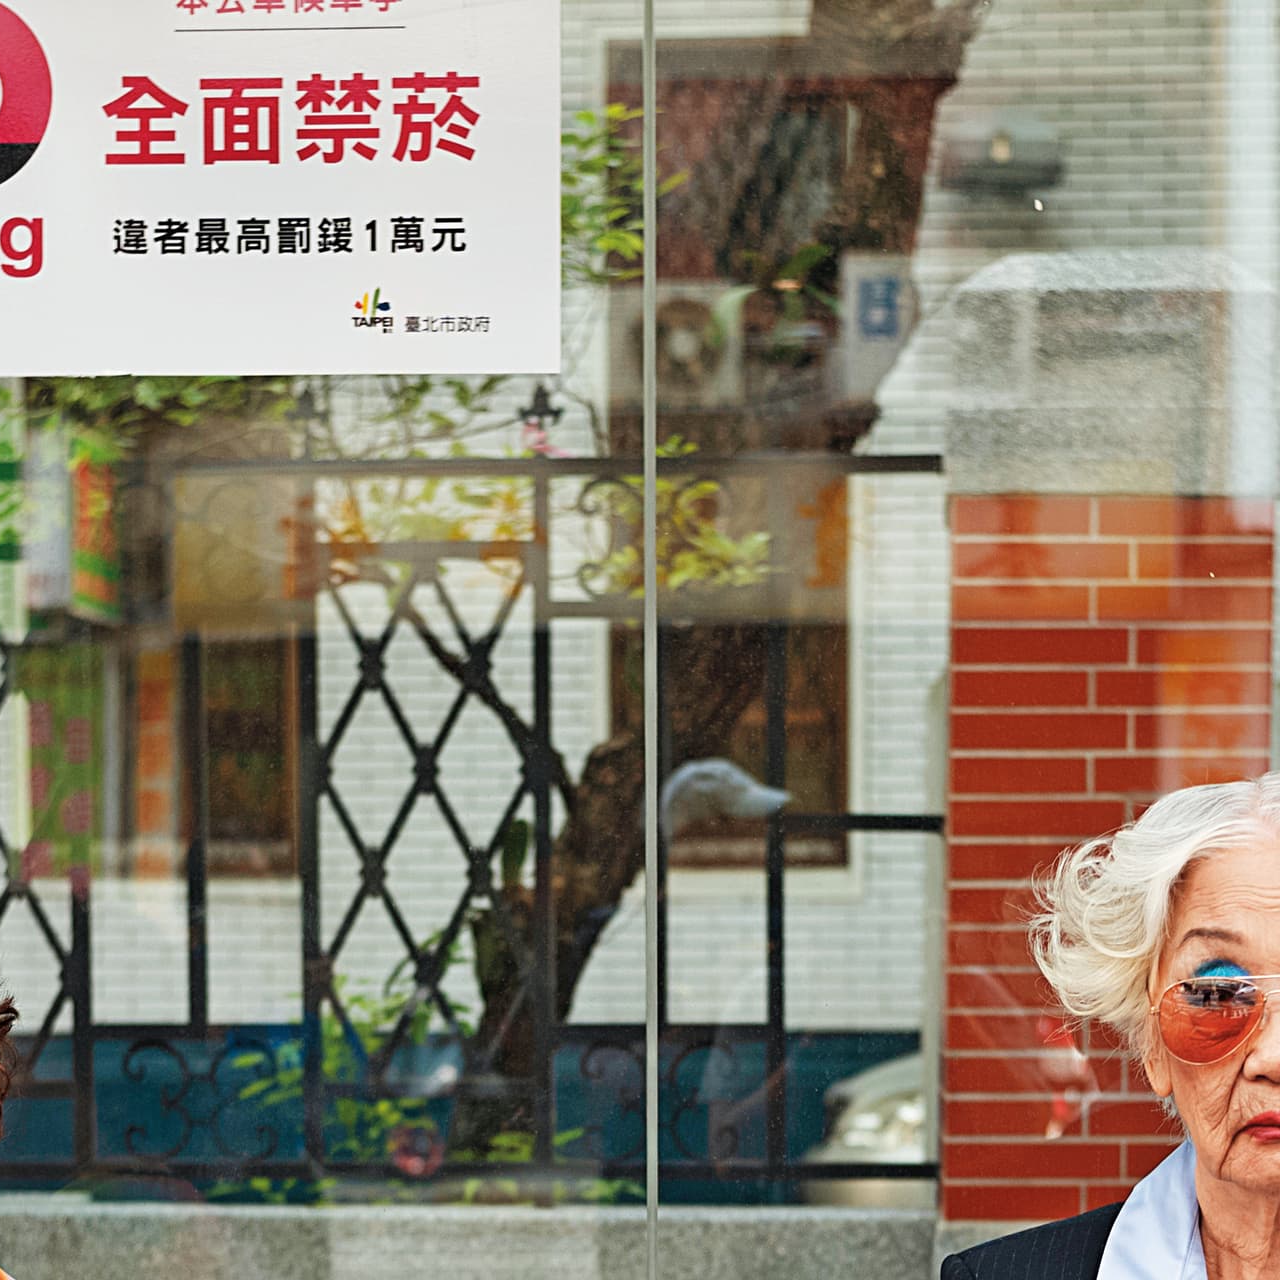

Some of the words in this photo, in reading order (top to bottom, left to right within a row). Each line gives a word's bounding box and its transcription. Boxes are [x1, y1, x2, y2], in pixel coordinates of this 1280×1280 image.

[102, 73, 482, 167] 全面禁菸
[352, 316, 393, 327] TAIPEI
[405, 316, 490, 333] 臺北市政府
